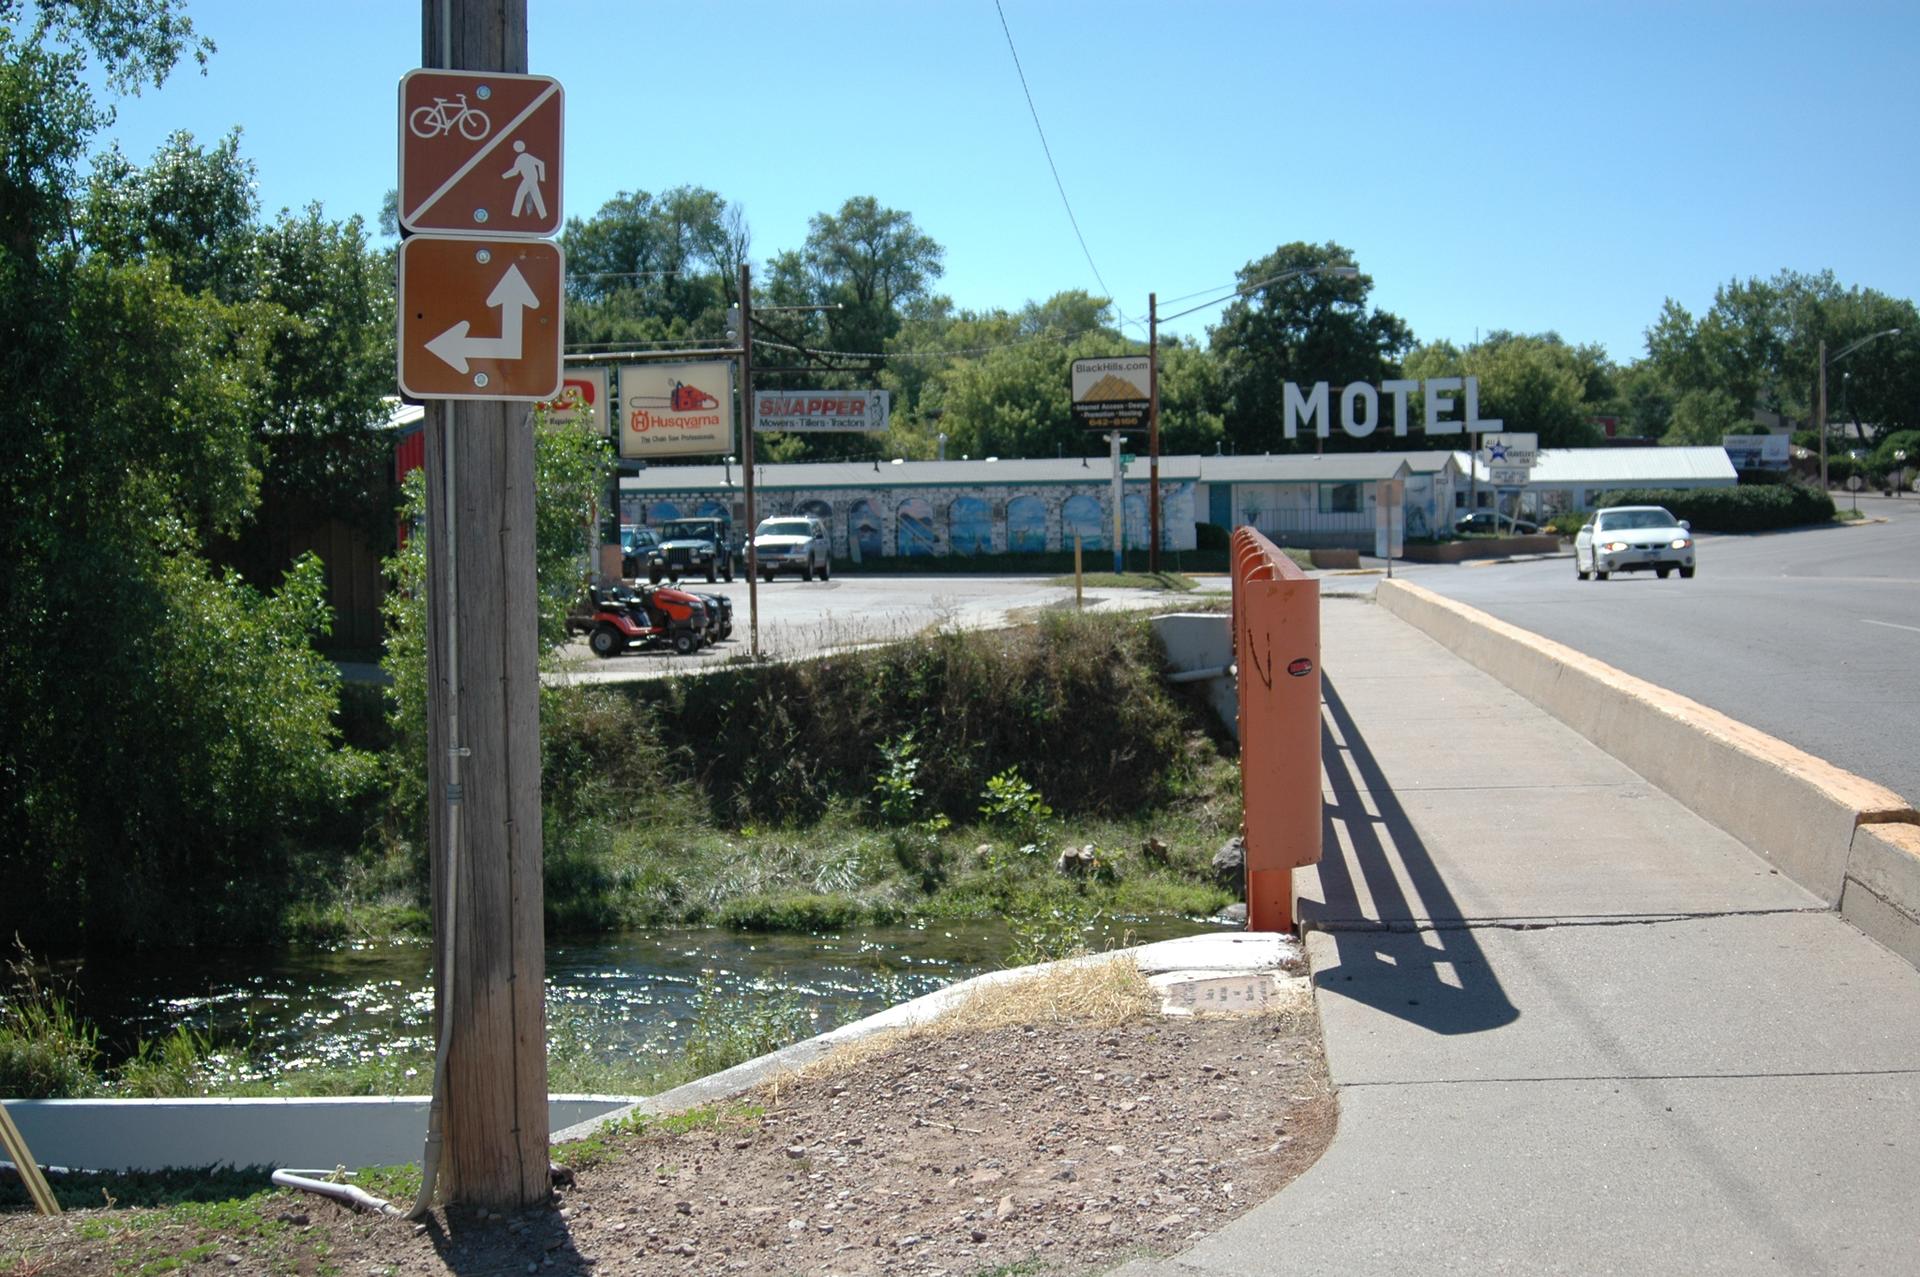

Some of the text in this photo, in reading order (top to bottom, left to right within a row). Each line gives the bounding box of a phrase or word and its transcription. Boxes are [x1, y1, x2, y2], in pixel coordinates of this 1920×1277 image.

[1075, 361, 1149, 374] BlackHills.com
[759, 398, 866, 417] SNAPPER
[1283, 376, 1503, 439] MOTEL
[651, 414, 720, 430] Husqvarna
[760, 418, 865, 428] Mowers Tillers Tractors
[641, 435, 651, 444] The
[652, 434, 667, 443] Chain
